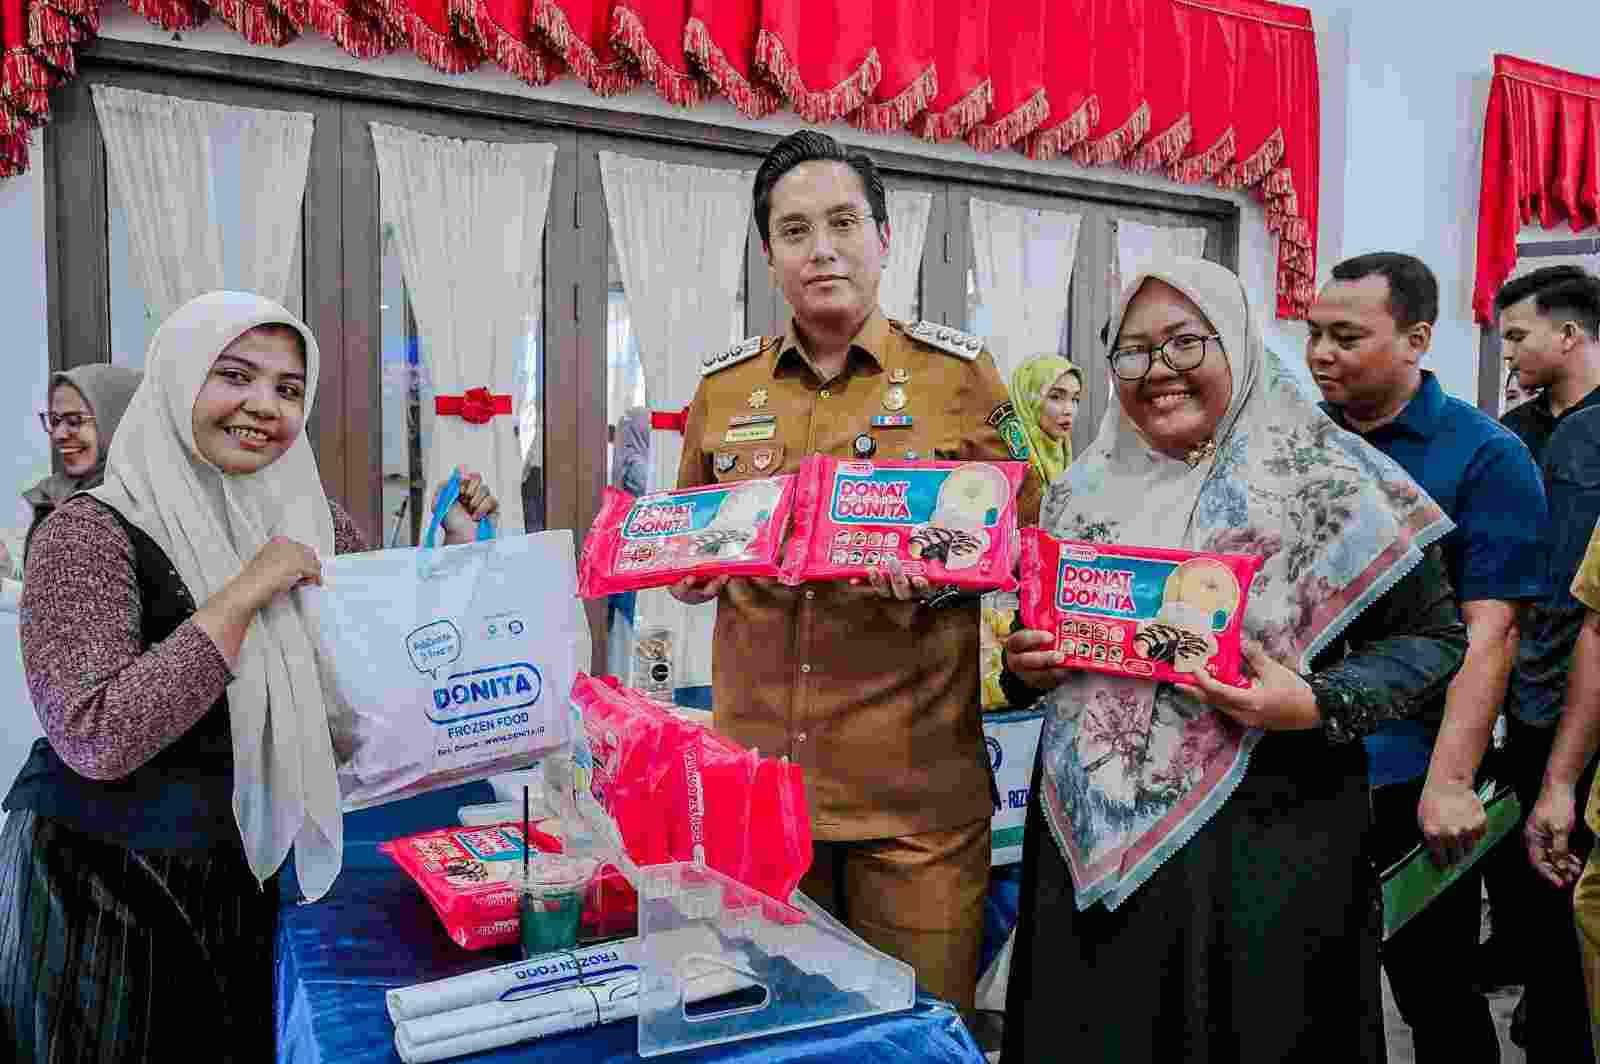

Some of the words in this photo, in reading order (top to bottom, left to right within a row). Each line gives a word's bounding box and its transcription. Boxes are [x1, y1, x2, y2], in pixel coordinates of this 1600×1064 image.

[840, 481, 909, 498] DONAT
[838, 501, 911, 518] DONITA
[1063, 565, 1134, 588] DONAT
[1062, 588, 1135, 610] DONITA
[432, 673, 531, 710] DONITA
[447, 719, 496, 739] FROZEN
[496, 711, 529, 729] FOOD
[514, 963, 559, 980] FOOD
[559, 952, 619, 971] FROZEN
